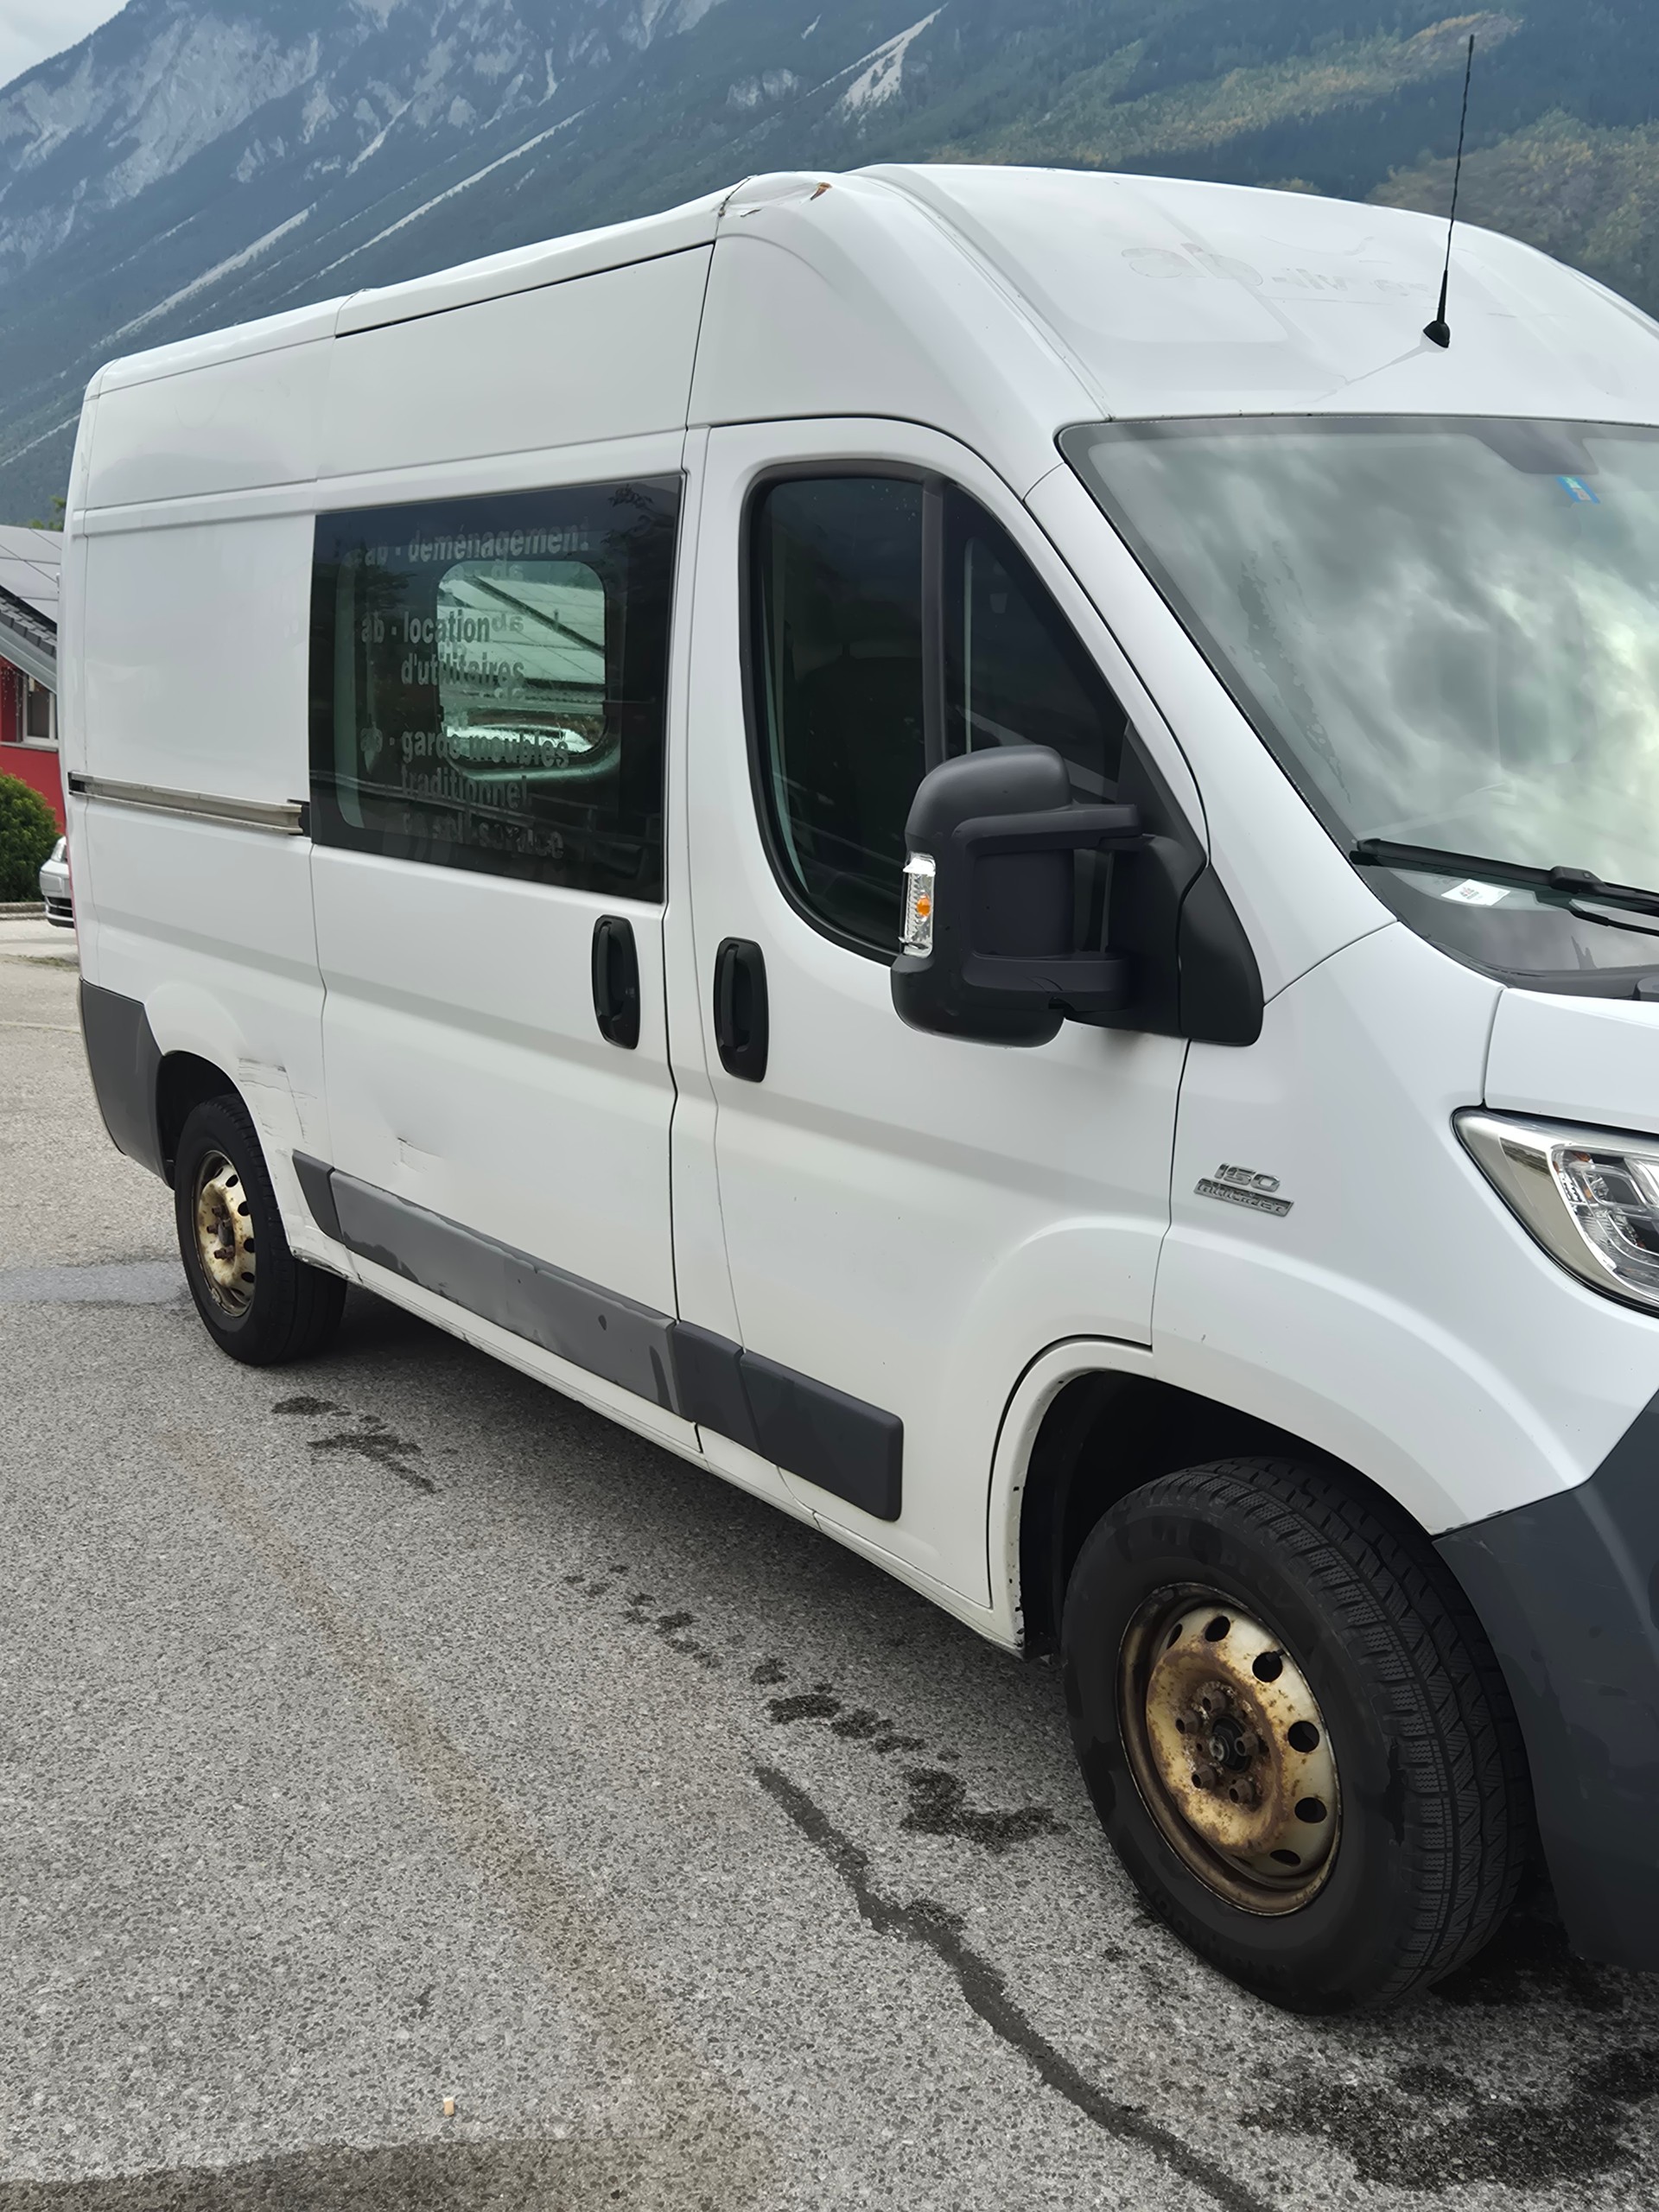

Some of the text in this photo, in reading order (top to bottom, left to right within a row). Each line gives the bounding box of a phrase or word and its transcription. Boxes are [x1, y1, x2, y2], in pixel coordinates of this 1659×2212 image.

[361, 610, 385, 643] ab
[404, 609, 490, 644] location
[1213, 1163, 1281, 1192] 150
